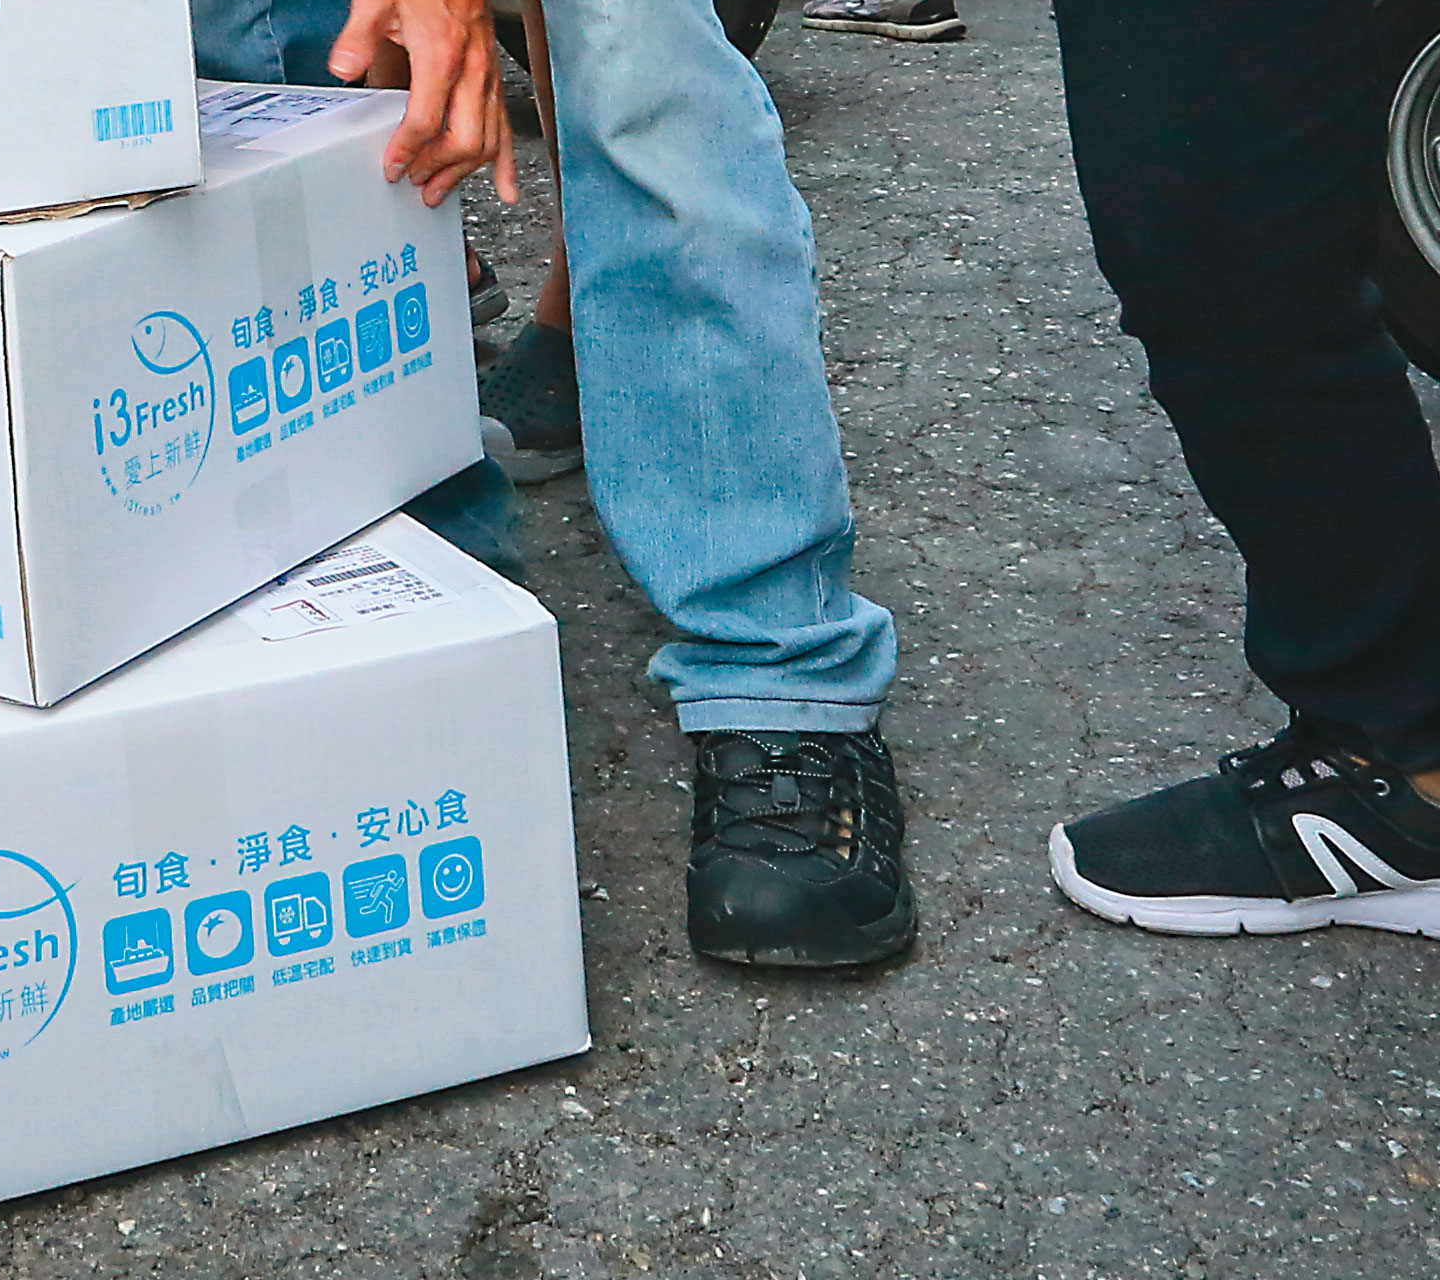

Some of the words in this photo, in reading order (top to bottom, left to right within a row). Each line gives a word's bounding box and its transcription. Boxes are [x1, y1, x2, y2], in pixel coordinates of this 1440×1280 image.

[93, 381, 205, 456] i3Fresh
[125, 427, 202, 490] 愛上新鮮
